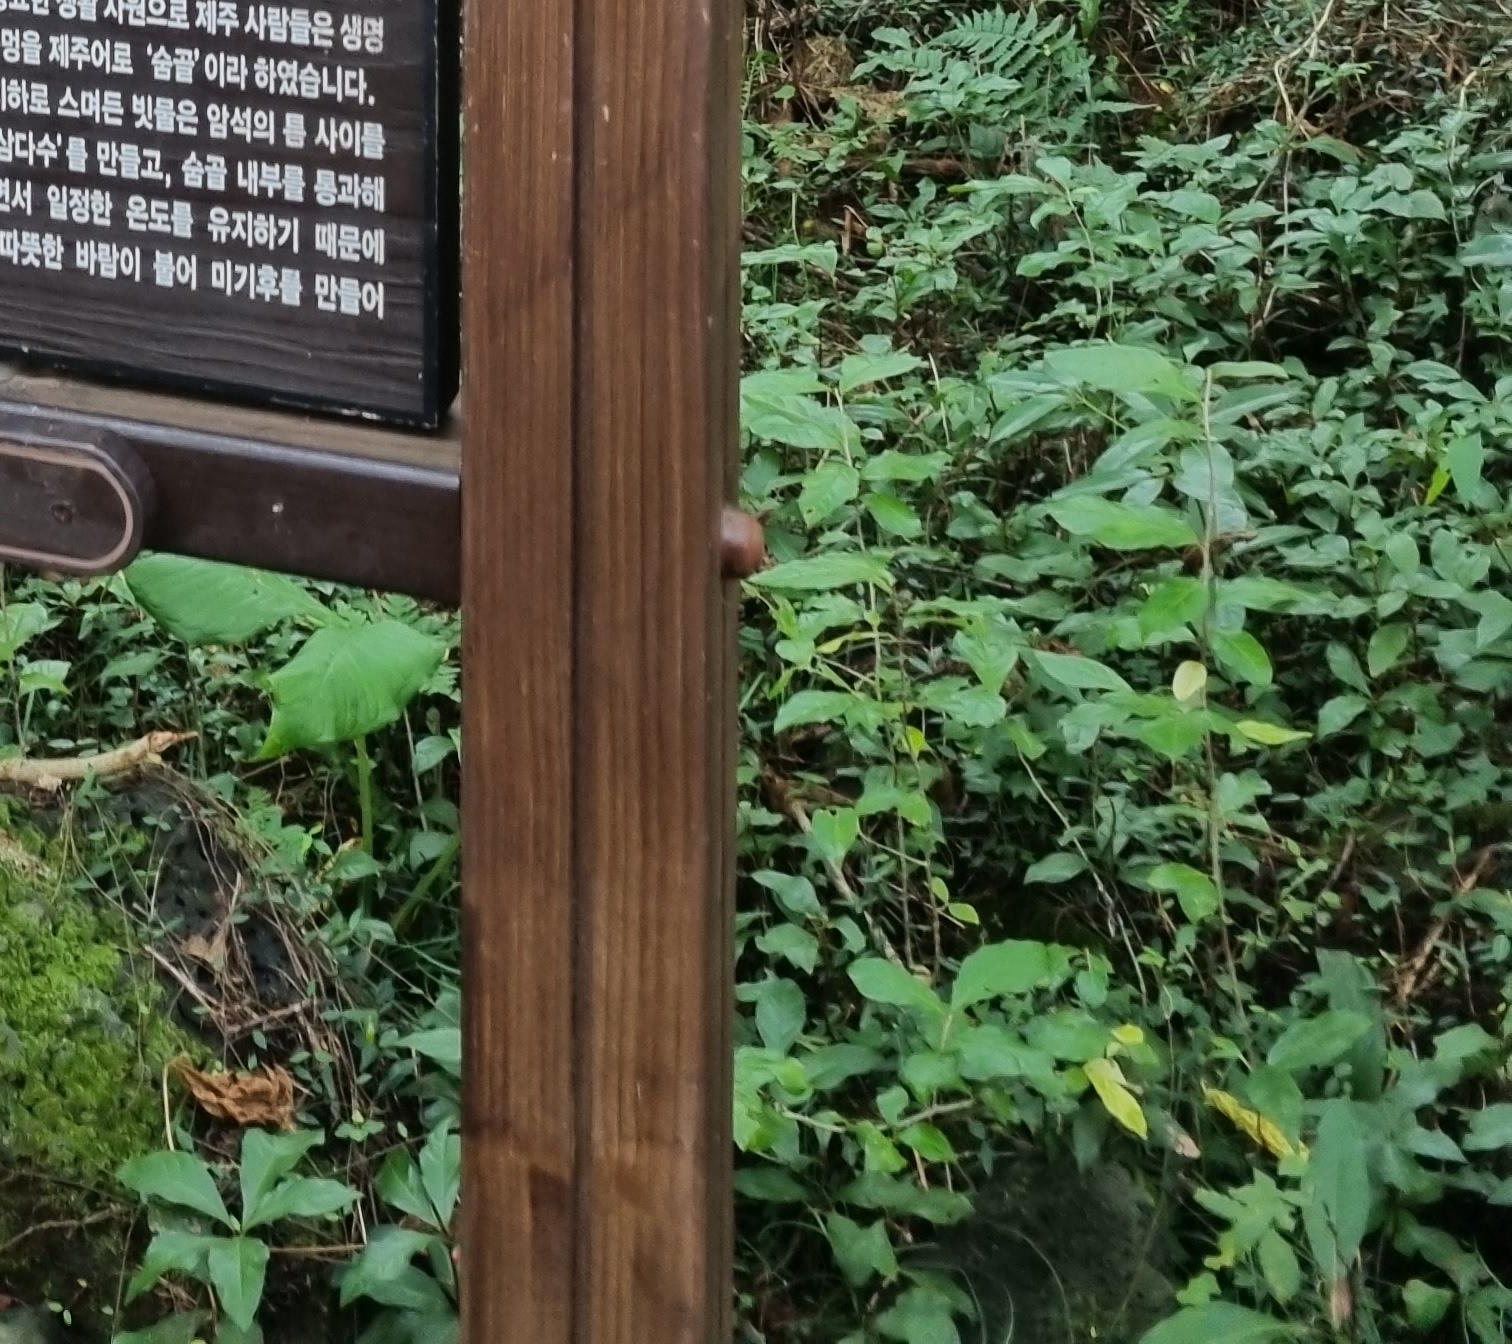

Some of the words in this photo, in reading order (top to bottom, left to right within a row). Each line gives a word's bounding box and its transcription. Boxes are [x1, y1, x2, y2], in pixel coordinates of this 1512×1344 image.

[194, 0, 240, 37] 제주
[244, 4, 335, 47] 사람들은
[340, 14, 384, 53] 생명
[48, 33, 134, 75] 제주어로
[253, 57, 375, 106] 하였습니다.
[57, 86, 124, 126] 스며든
[132, 94, 199, 136] 빗물은
[206, 103, 275, 145] 암석의
[282, 112, 307, 149] 틈
[314, 117, 386, 160] 사이를
[96, 141, 171, 189] 만들고,
[181, 150, 228, 191] 숨골
[237, 160, 306, 202] 내부를
[313, 169, 385, 212] 통과해
[46, 184, 113, 227] 일정한
[125, 195, 194, 239] 온도를
[207, 206, 299, 254] 유지하기
[315, 222, 385, 265] 때문에
[0, 228, 65, 271] 따뜻한
[75, 239, 141, 282] 바람이
[152, 249, 197, 291] 불어
[211, 259, 303, 307] 미기후를
[314, 274, 384, 319] 만들어
